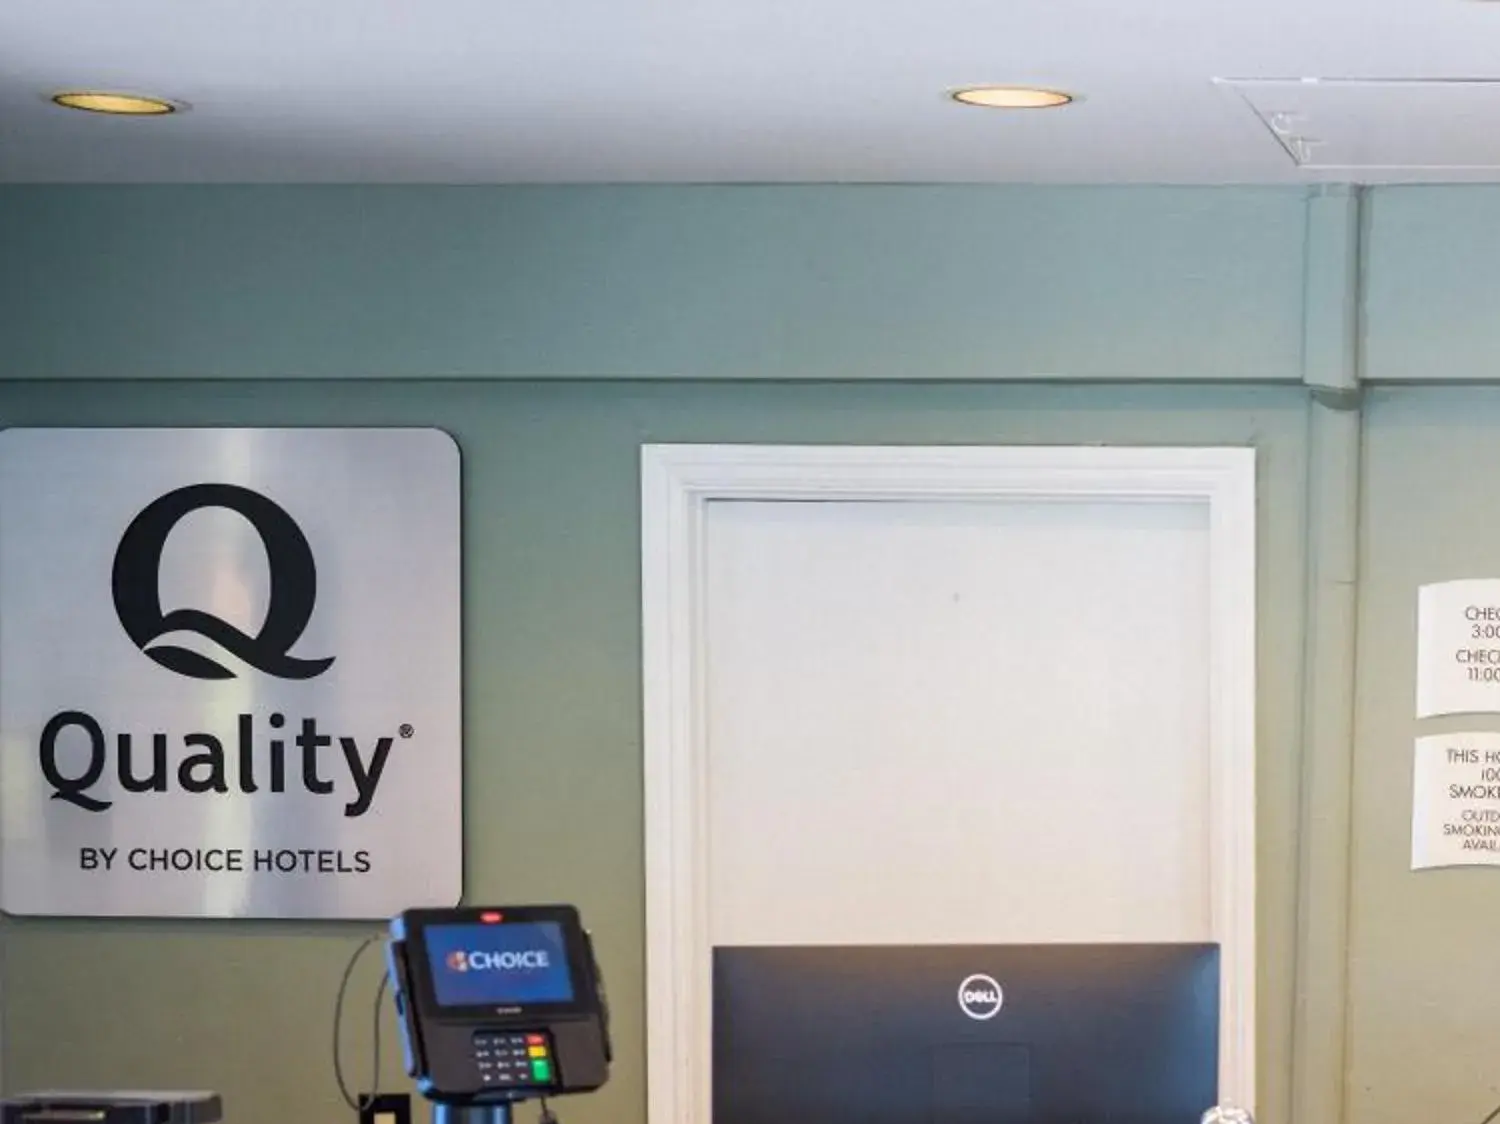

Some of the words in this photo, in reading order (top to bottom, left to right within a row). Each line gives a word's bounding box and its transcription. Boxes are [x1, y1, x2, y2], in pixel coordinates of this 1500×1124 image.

[1446, 748, 1479, 763] THIS
[80, 848, 118, 870] BY
[128, 848, 243, 871] CHOICE
[253, 850, 371, 872] HOTELS
[469, 951, 550, 970] CHOICE
[964, 990, 998, 1003] DELL
